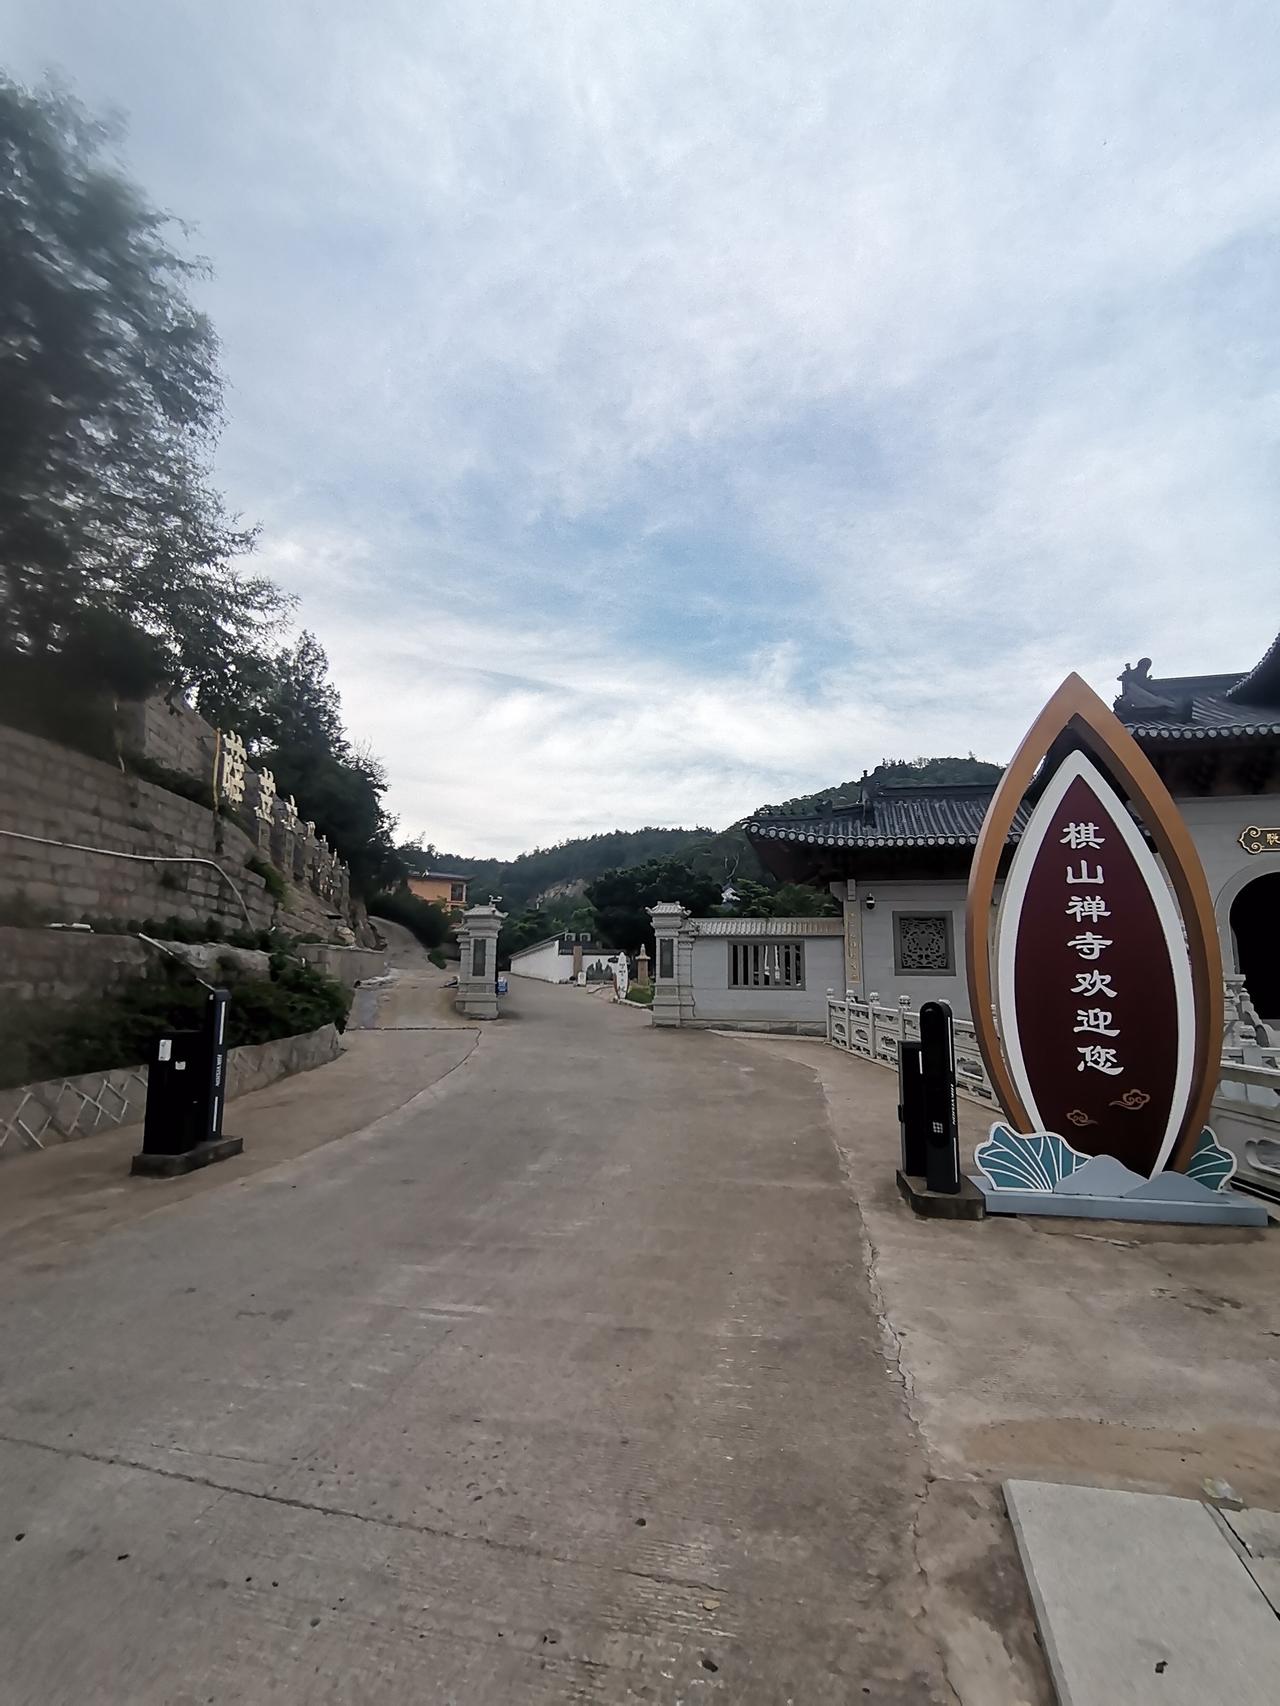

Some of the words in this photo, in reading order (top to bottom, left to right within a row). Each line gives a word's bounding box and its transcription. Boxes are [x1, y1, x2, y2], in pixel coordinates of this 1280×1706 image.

[1059, 821, 1124, 1076] 棋山禅寺欢迎您
